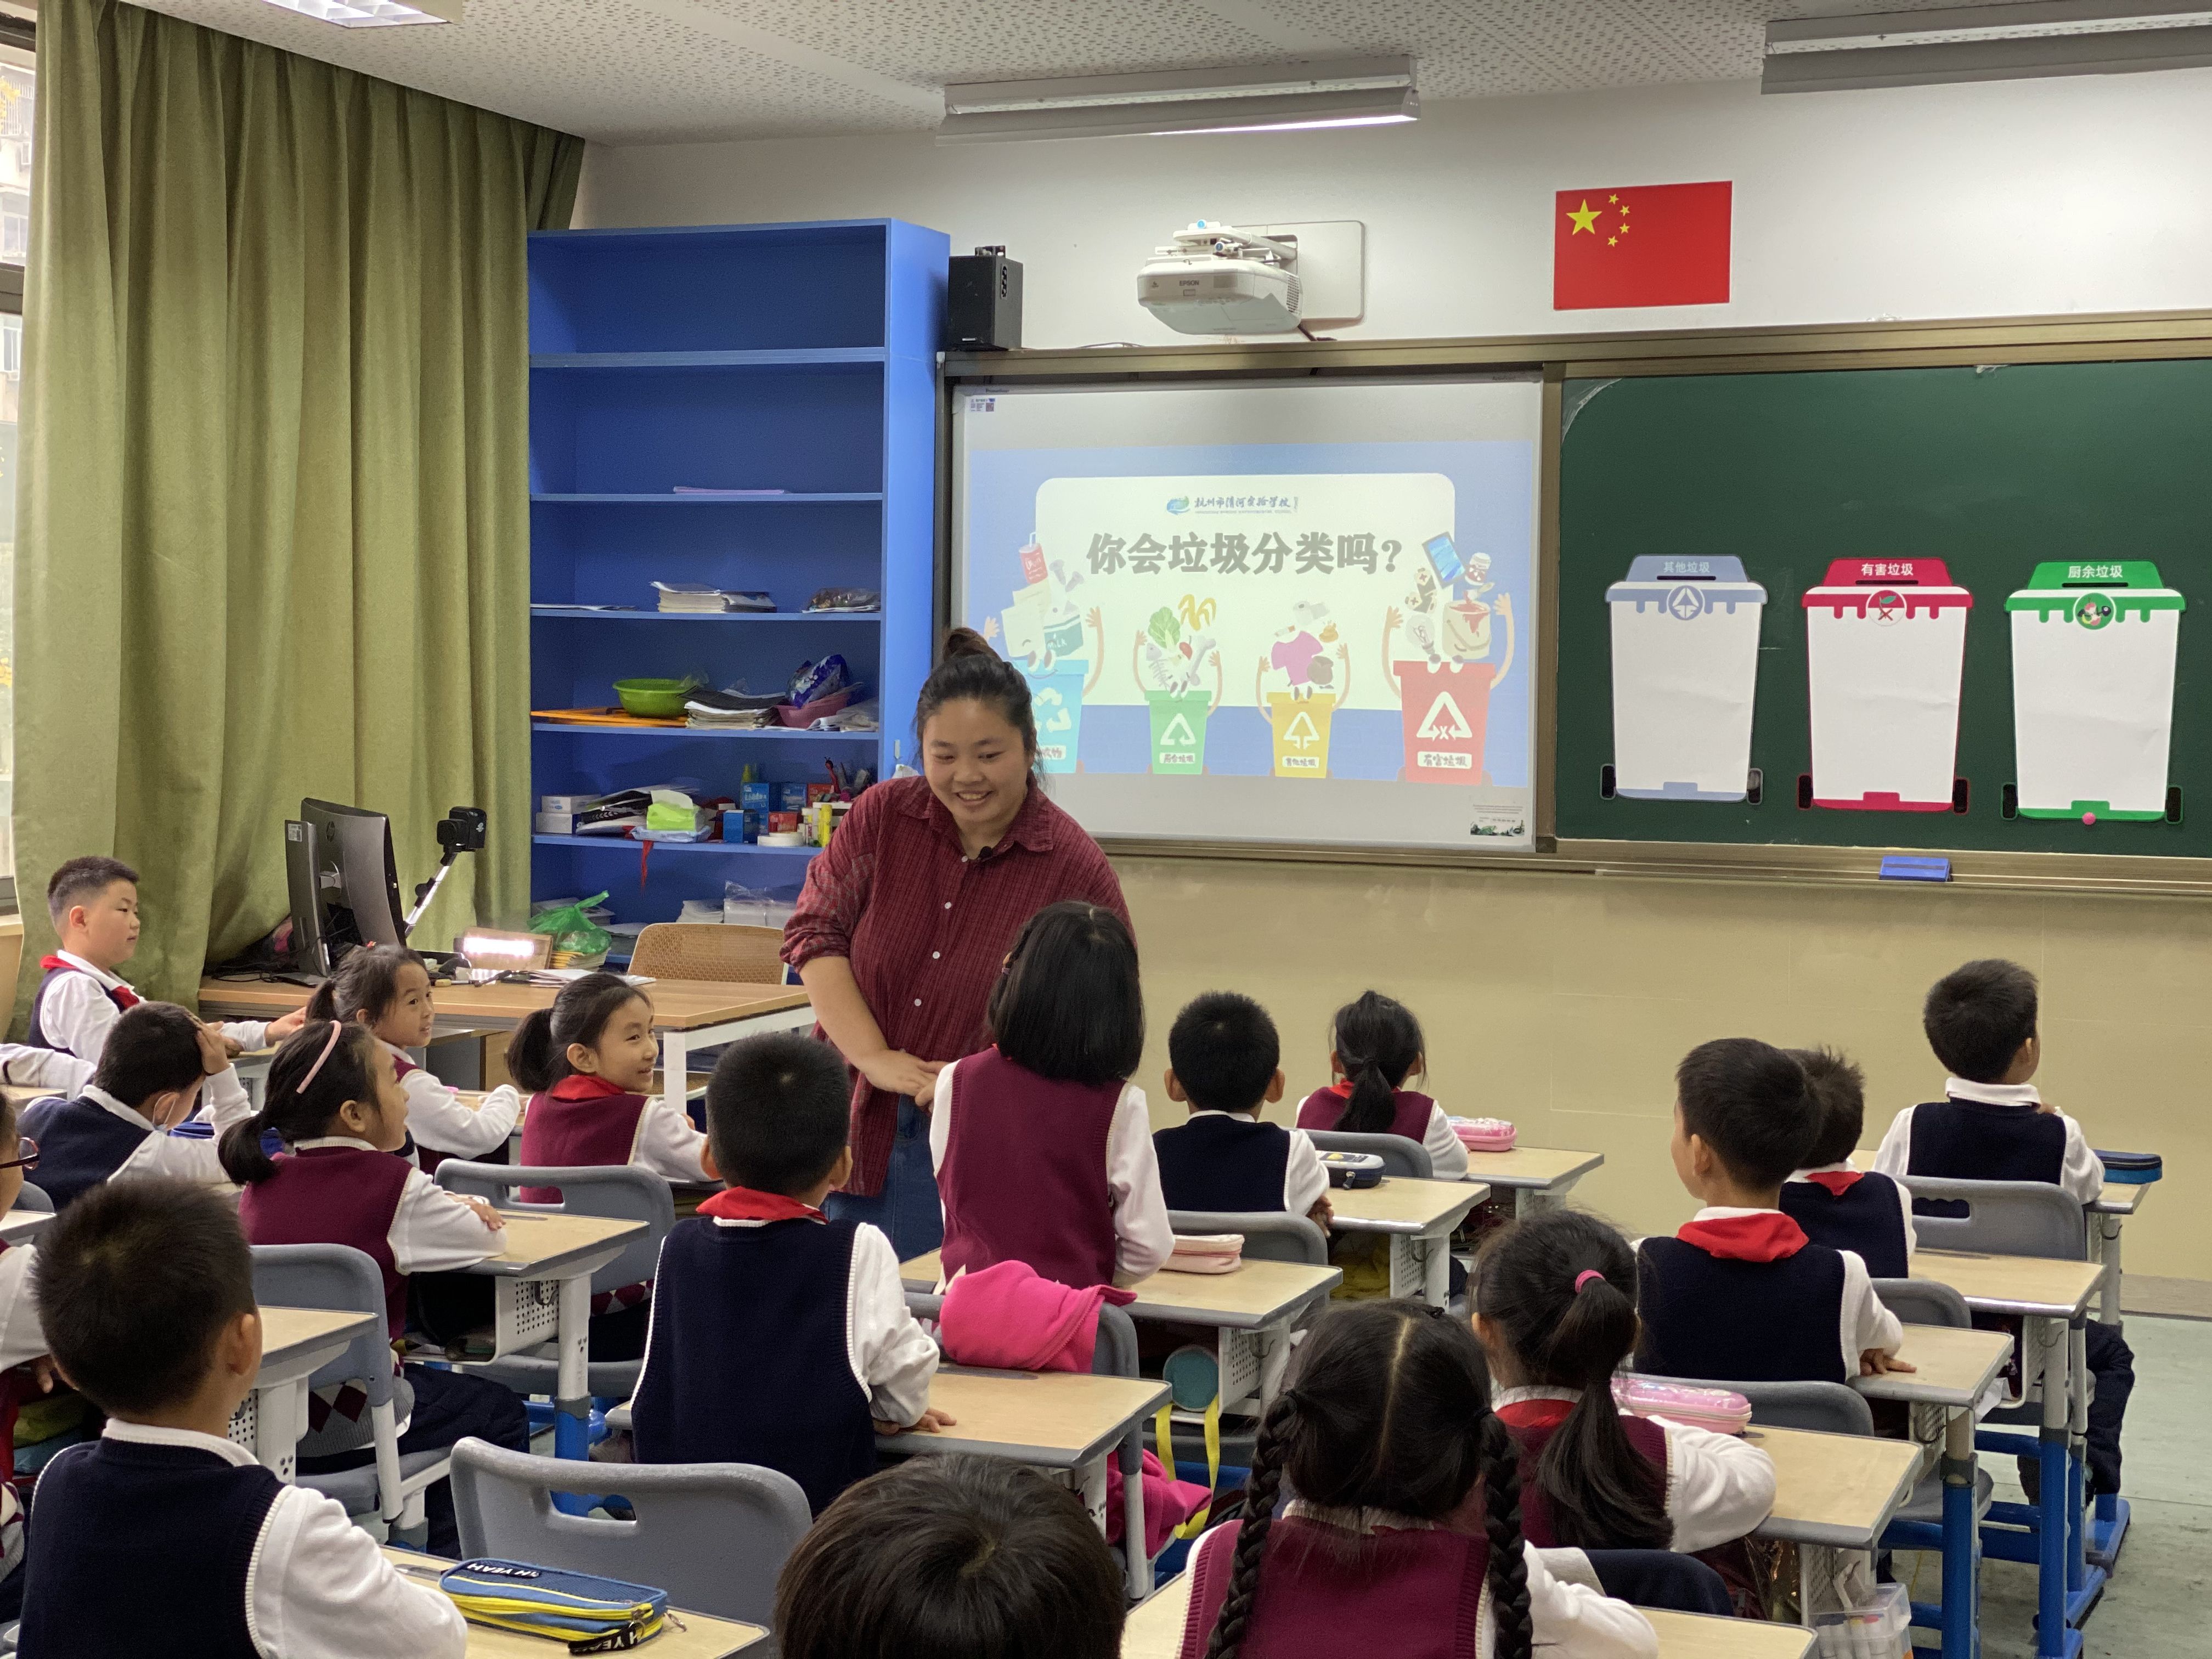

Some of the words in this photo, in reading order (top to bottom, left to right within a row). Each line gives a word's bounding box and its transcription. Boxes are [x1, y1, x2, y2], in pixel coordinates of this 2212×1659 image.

[1086, 532, 1402, 575] 你会垃圾分类吗?
[1663, 561, 1711, 573] 其他垃圾
[1860, 562, 1914, 576] 有害垃圾
[2067, 565, 2124, 579] 厨余垃圾
[466, 1562, 514, 1574] YEAH
